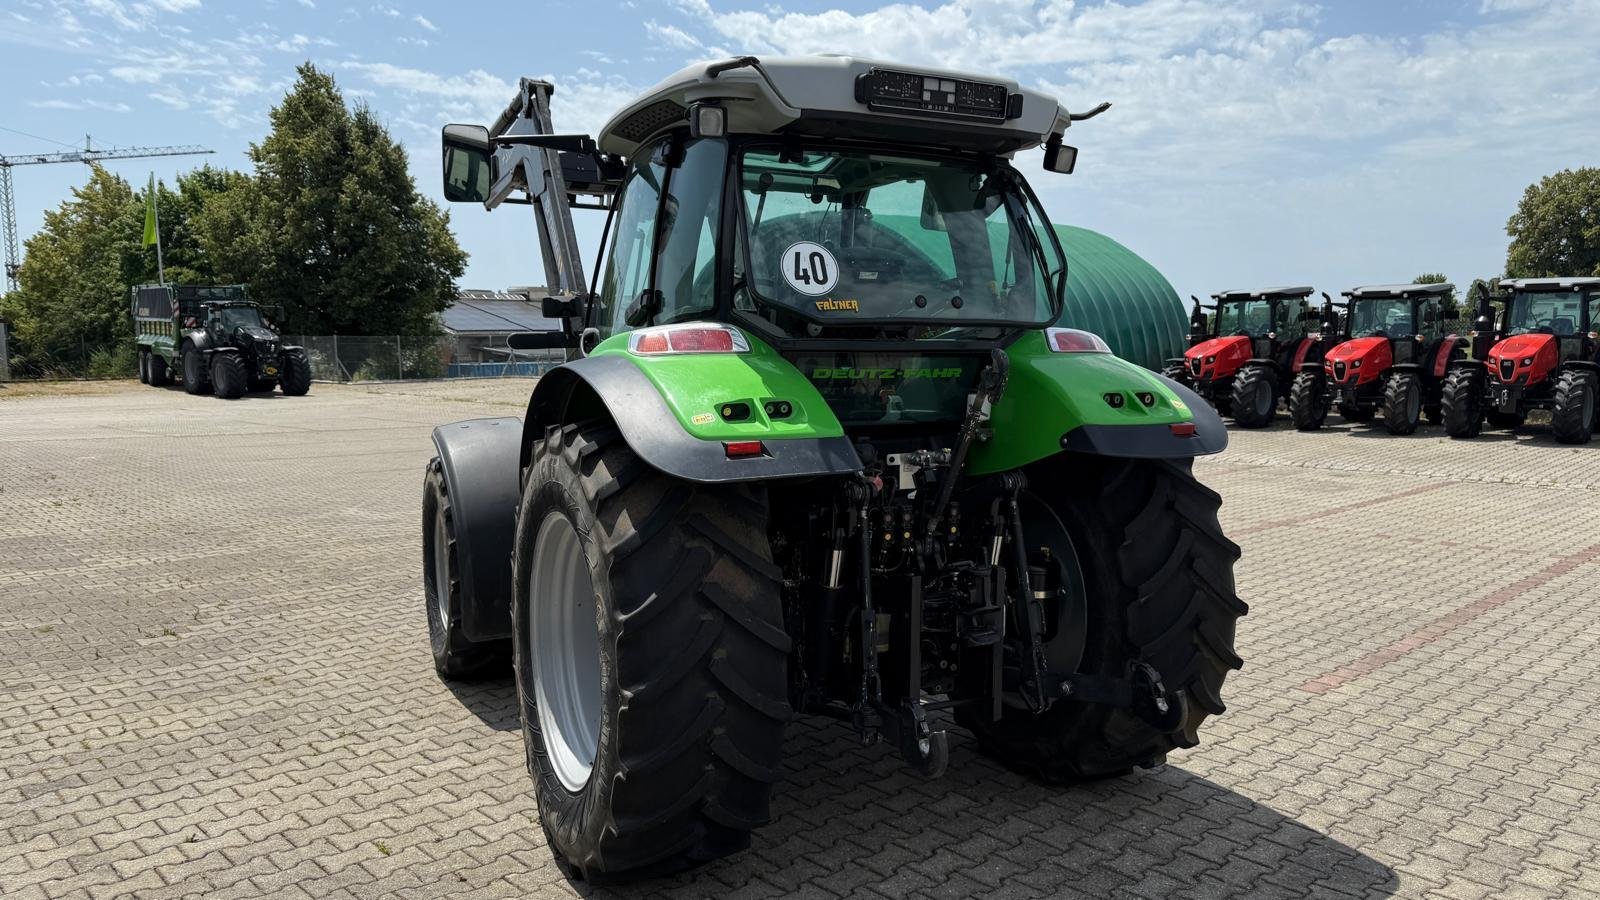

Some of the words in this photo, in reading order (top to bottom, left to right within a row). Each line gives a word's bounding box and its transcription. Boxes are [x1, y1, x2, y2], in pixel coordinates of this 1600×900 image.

[794, 251, 829, 286] 40
[815, 298, 859, 312] FALTNER
[812, 367, 963, 379] DEUTZ-FAHR
